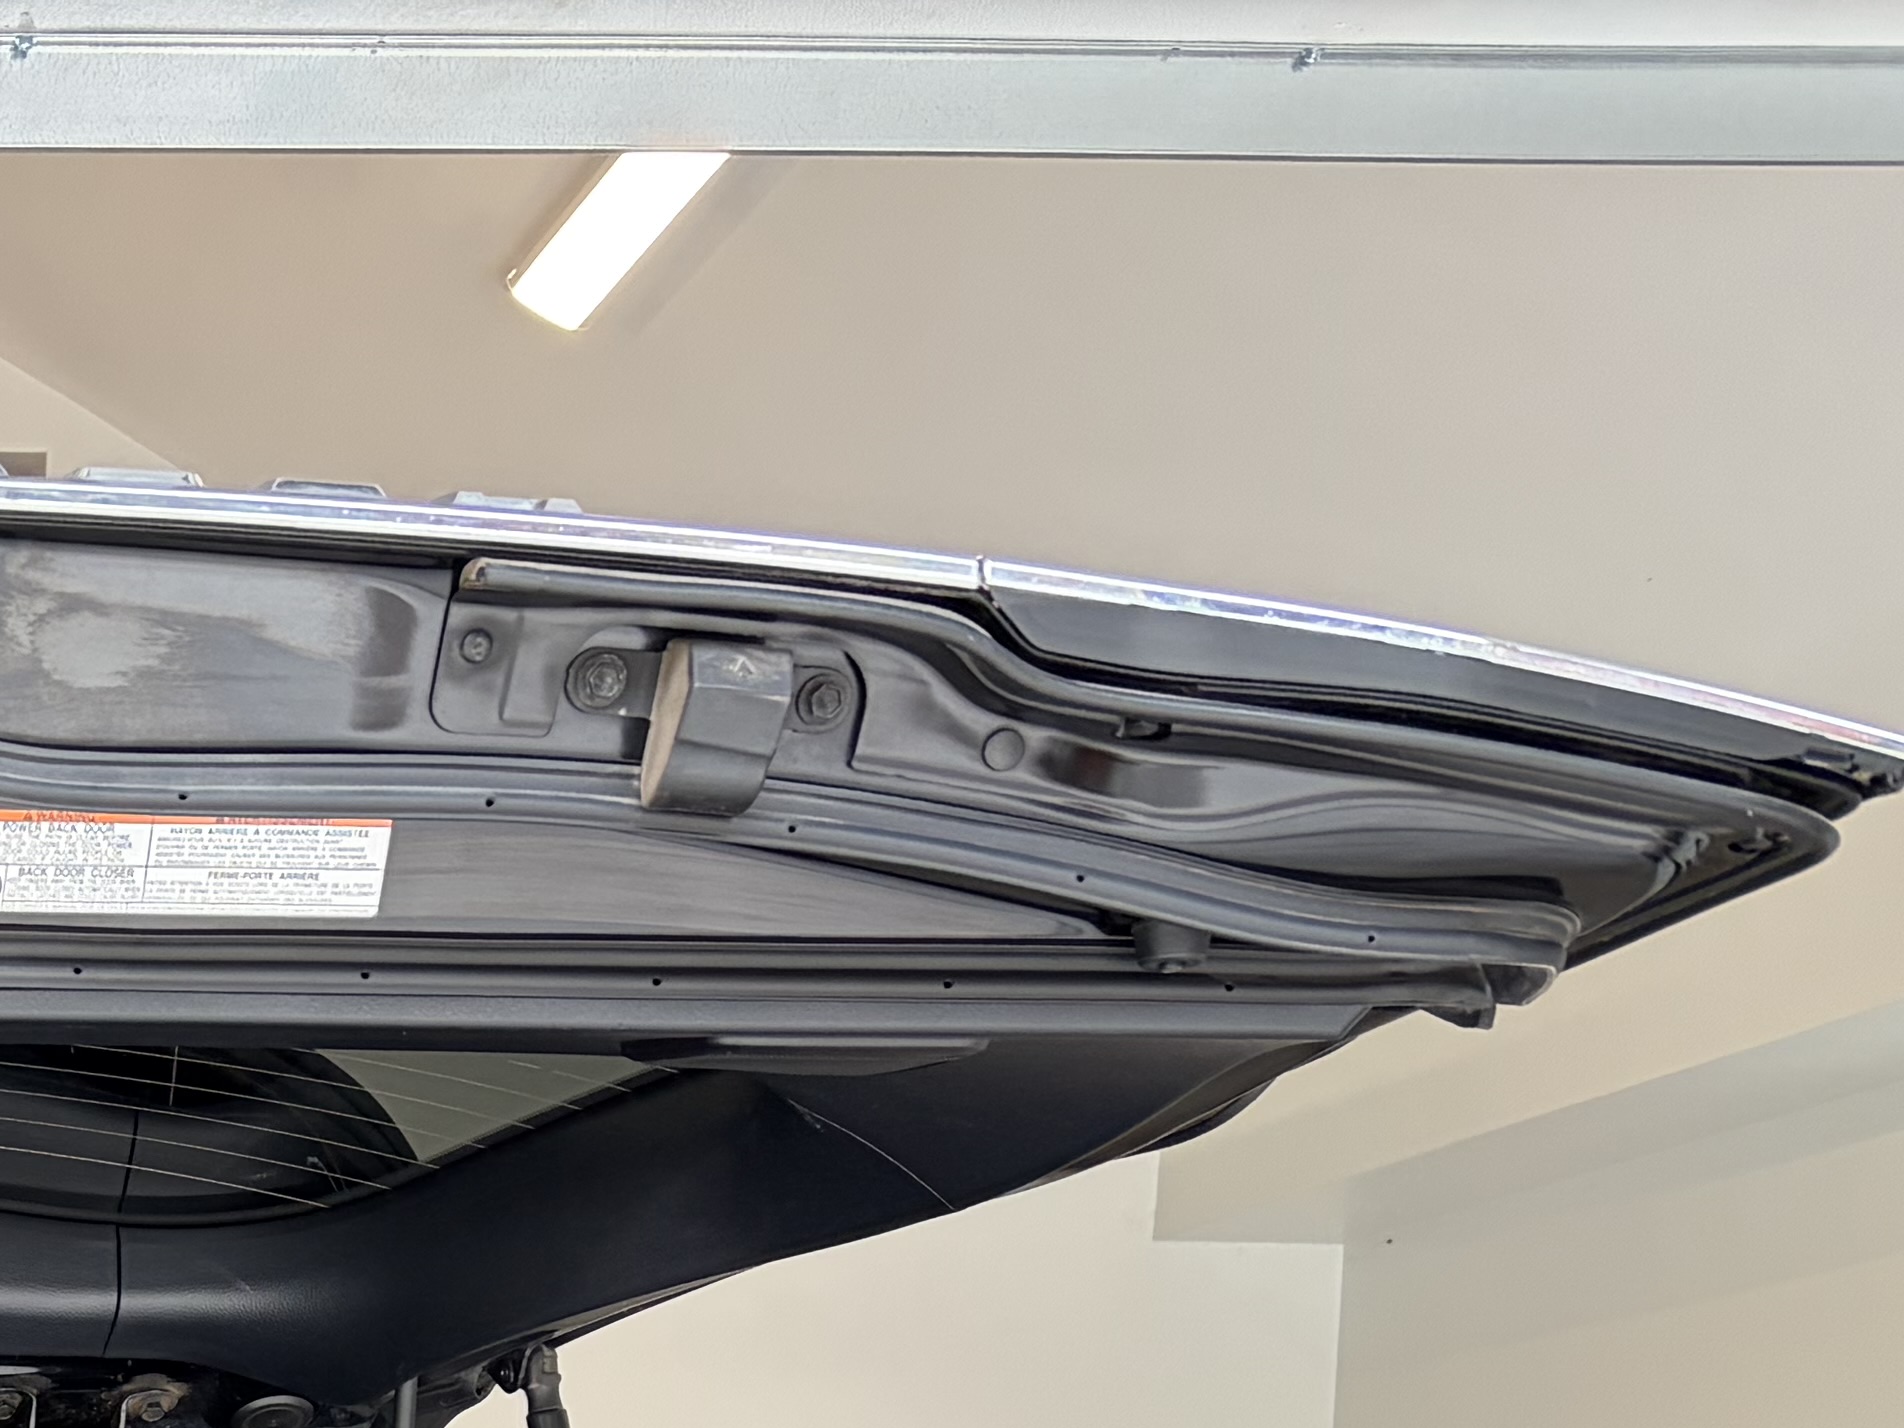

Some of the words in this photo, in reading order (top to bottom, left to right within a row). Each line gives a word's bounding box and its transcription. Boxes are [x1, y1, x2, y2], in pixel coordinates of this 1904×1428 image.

[3, 823, 41, 833] POWER
[84, 824, 115, 834] DOOR
[18, 867, 47, 877] BACK
[54, 867, 85, 877] DOOR
[91, 868, 134, 878] CLOSER
